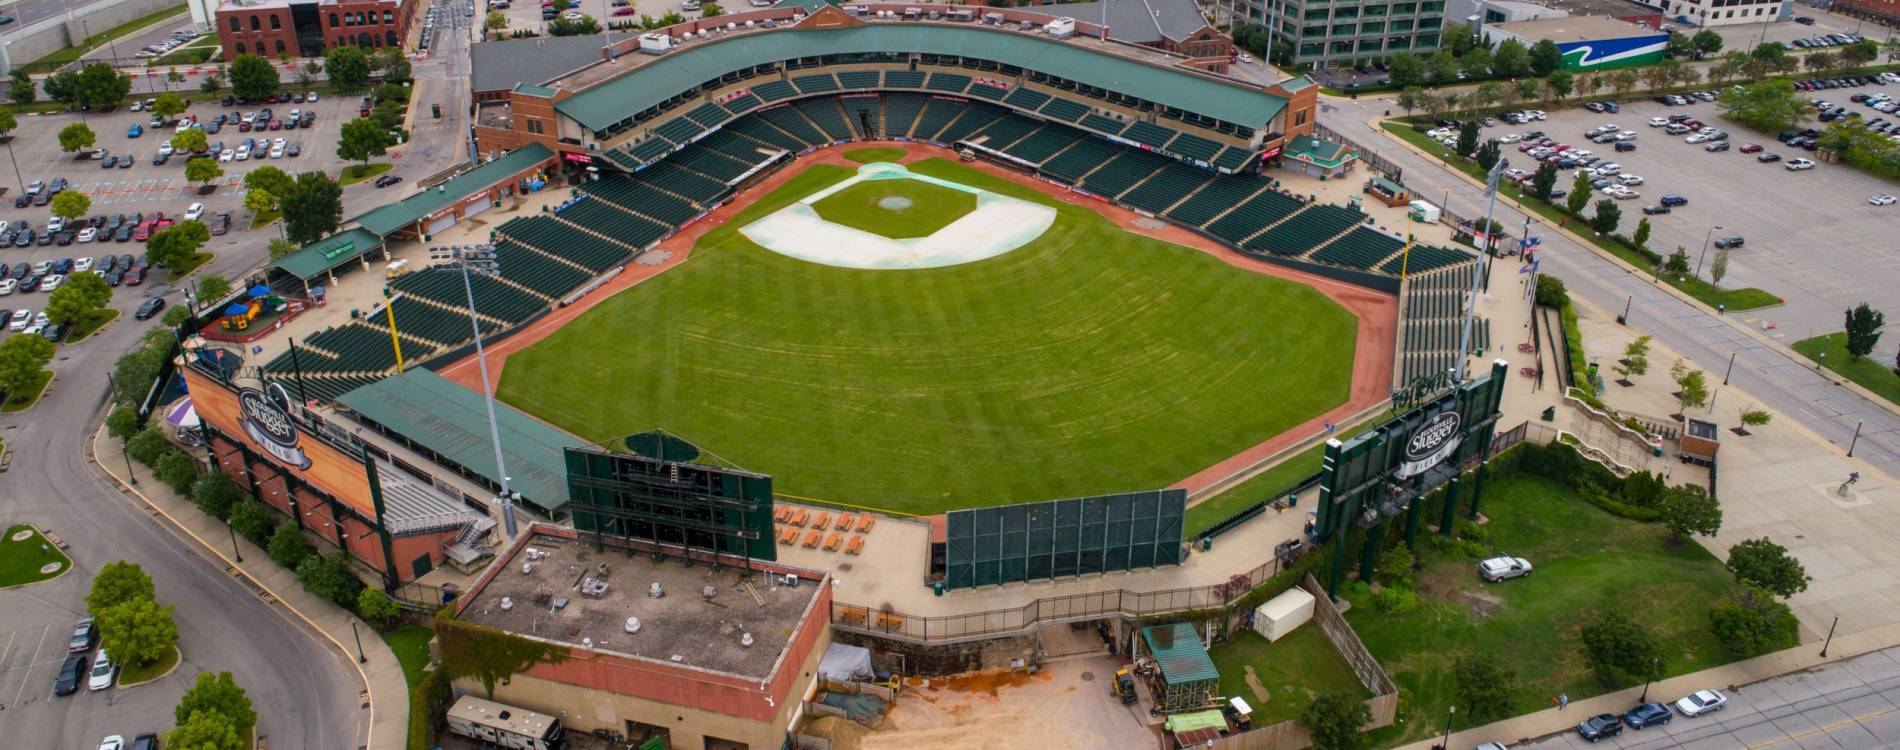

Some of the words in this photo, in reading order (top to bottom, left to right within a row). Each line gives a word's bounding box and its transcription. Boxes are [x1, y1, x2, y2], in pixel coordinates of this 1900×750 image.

[246, 397, 290, 438] Slugger
[255, 401, 287, 423] LOUISVILLE
[1411, 421, 1457, 453] Slugger
[1423, 415, 1455, 437] LOUISVILLE
